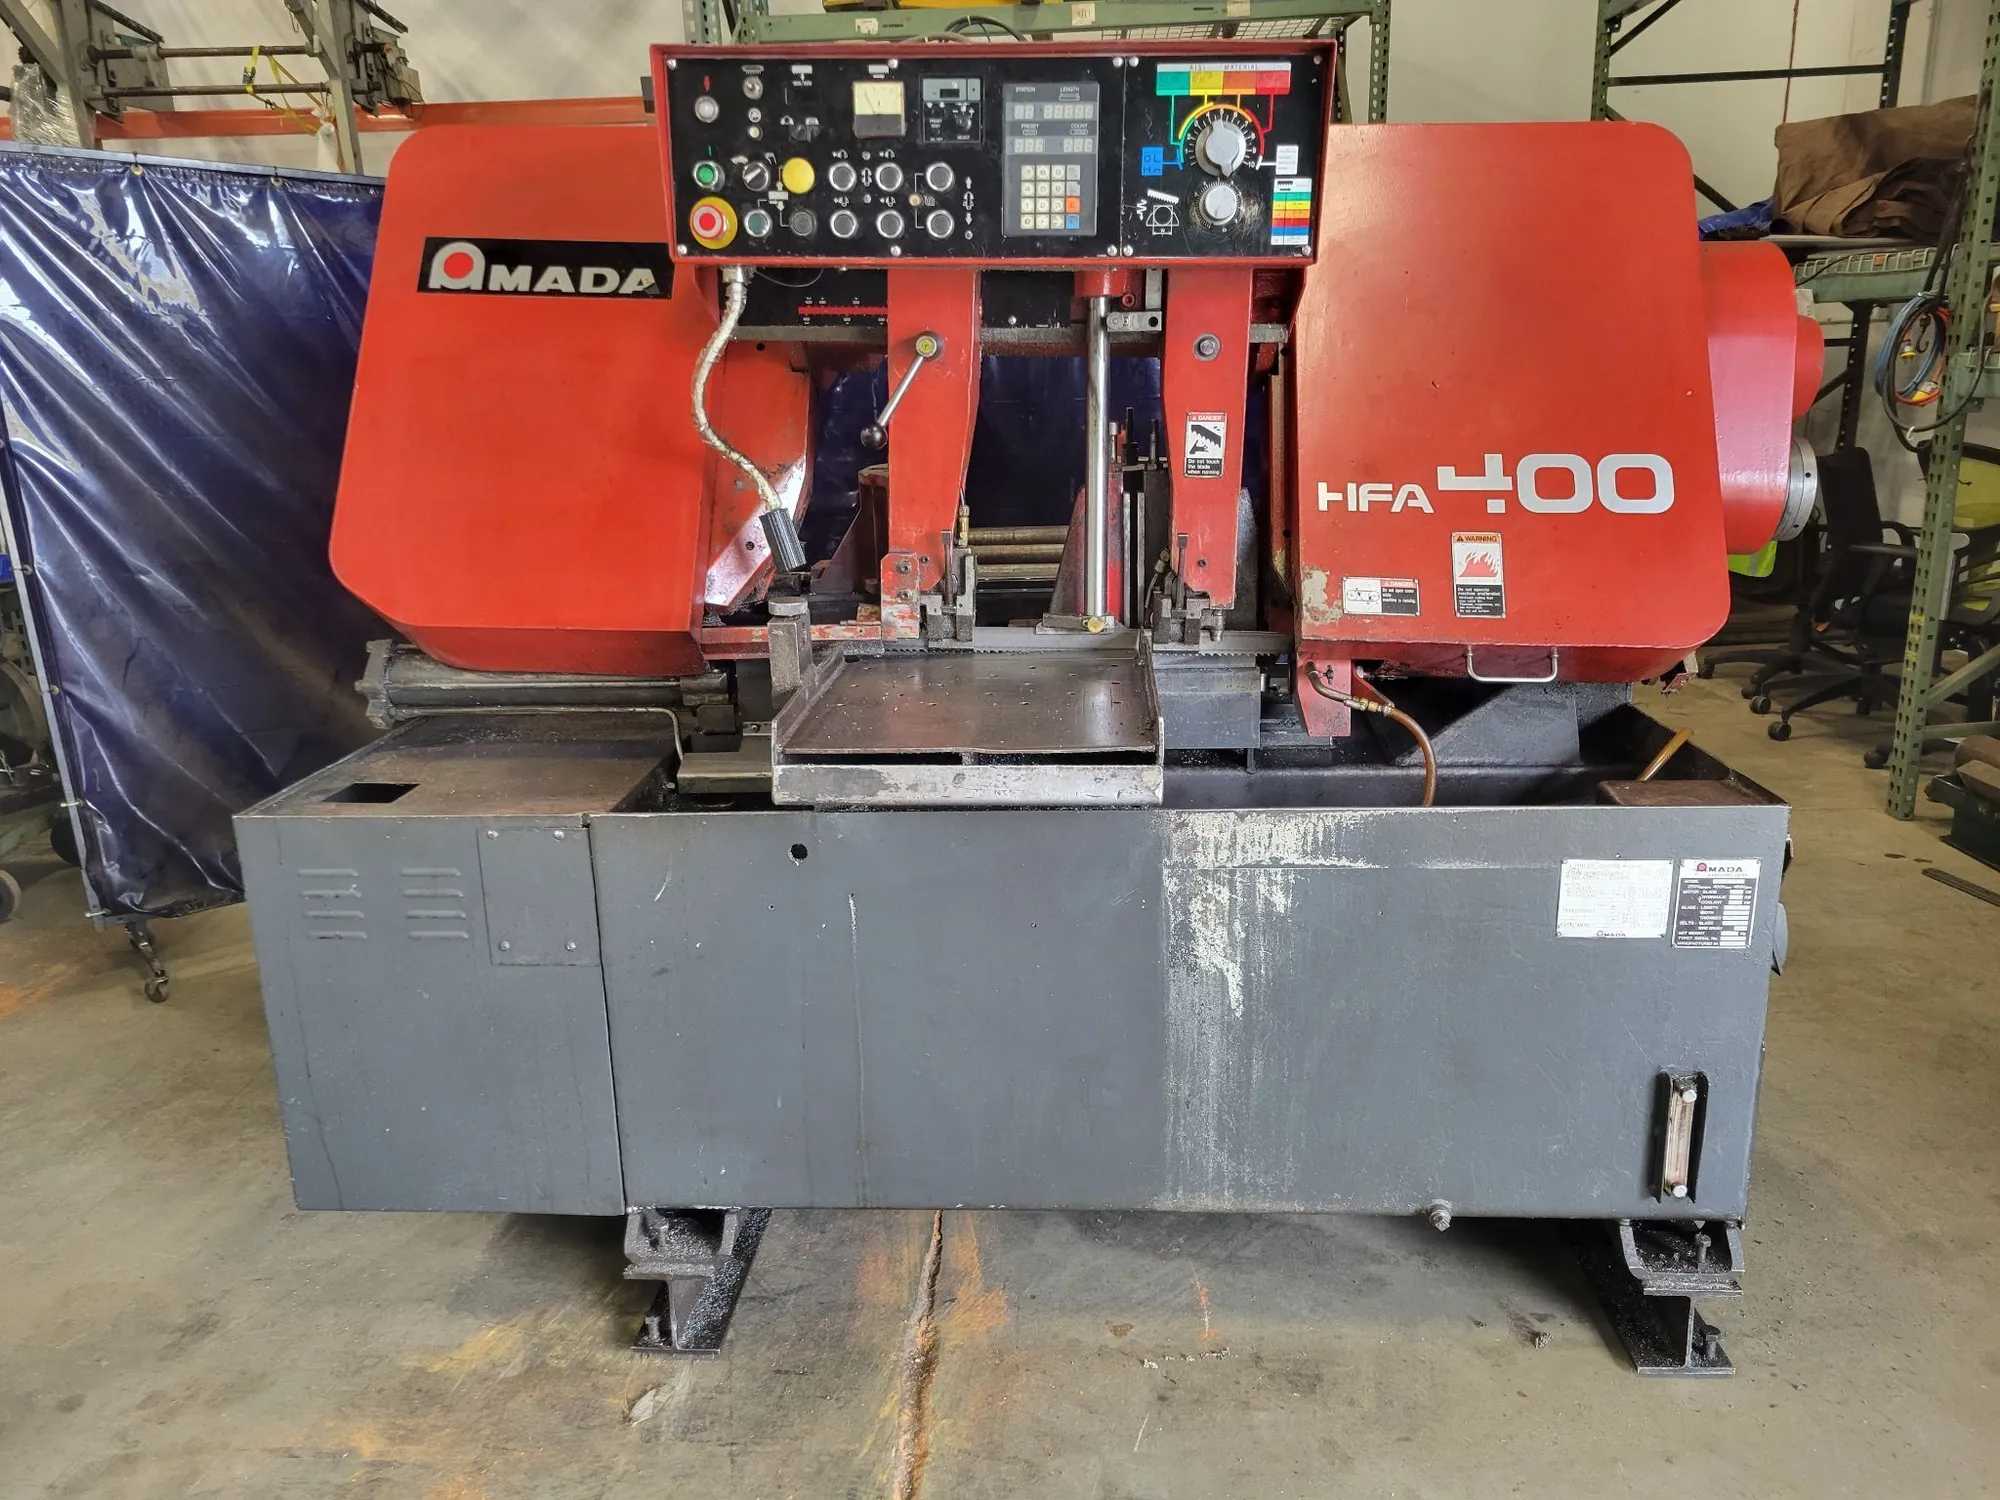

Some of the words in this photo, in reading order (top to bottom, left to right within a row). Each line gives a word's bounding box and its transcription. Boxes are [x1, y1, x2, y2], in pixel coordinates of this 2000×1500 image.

[428, 241, 660, 294] AMADA
[1317, 481, 1435, 513] HFA
[1437, 453, 1675, 514] 400
[1696, 862, 1742, 872] AMADA
